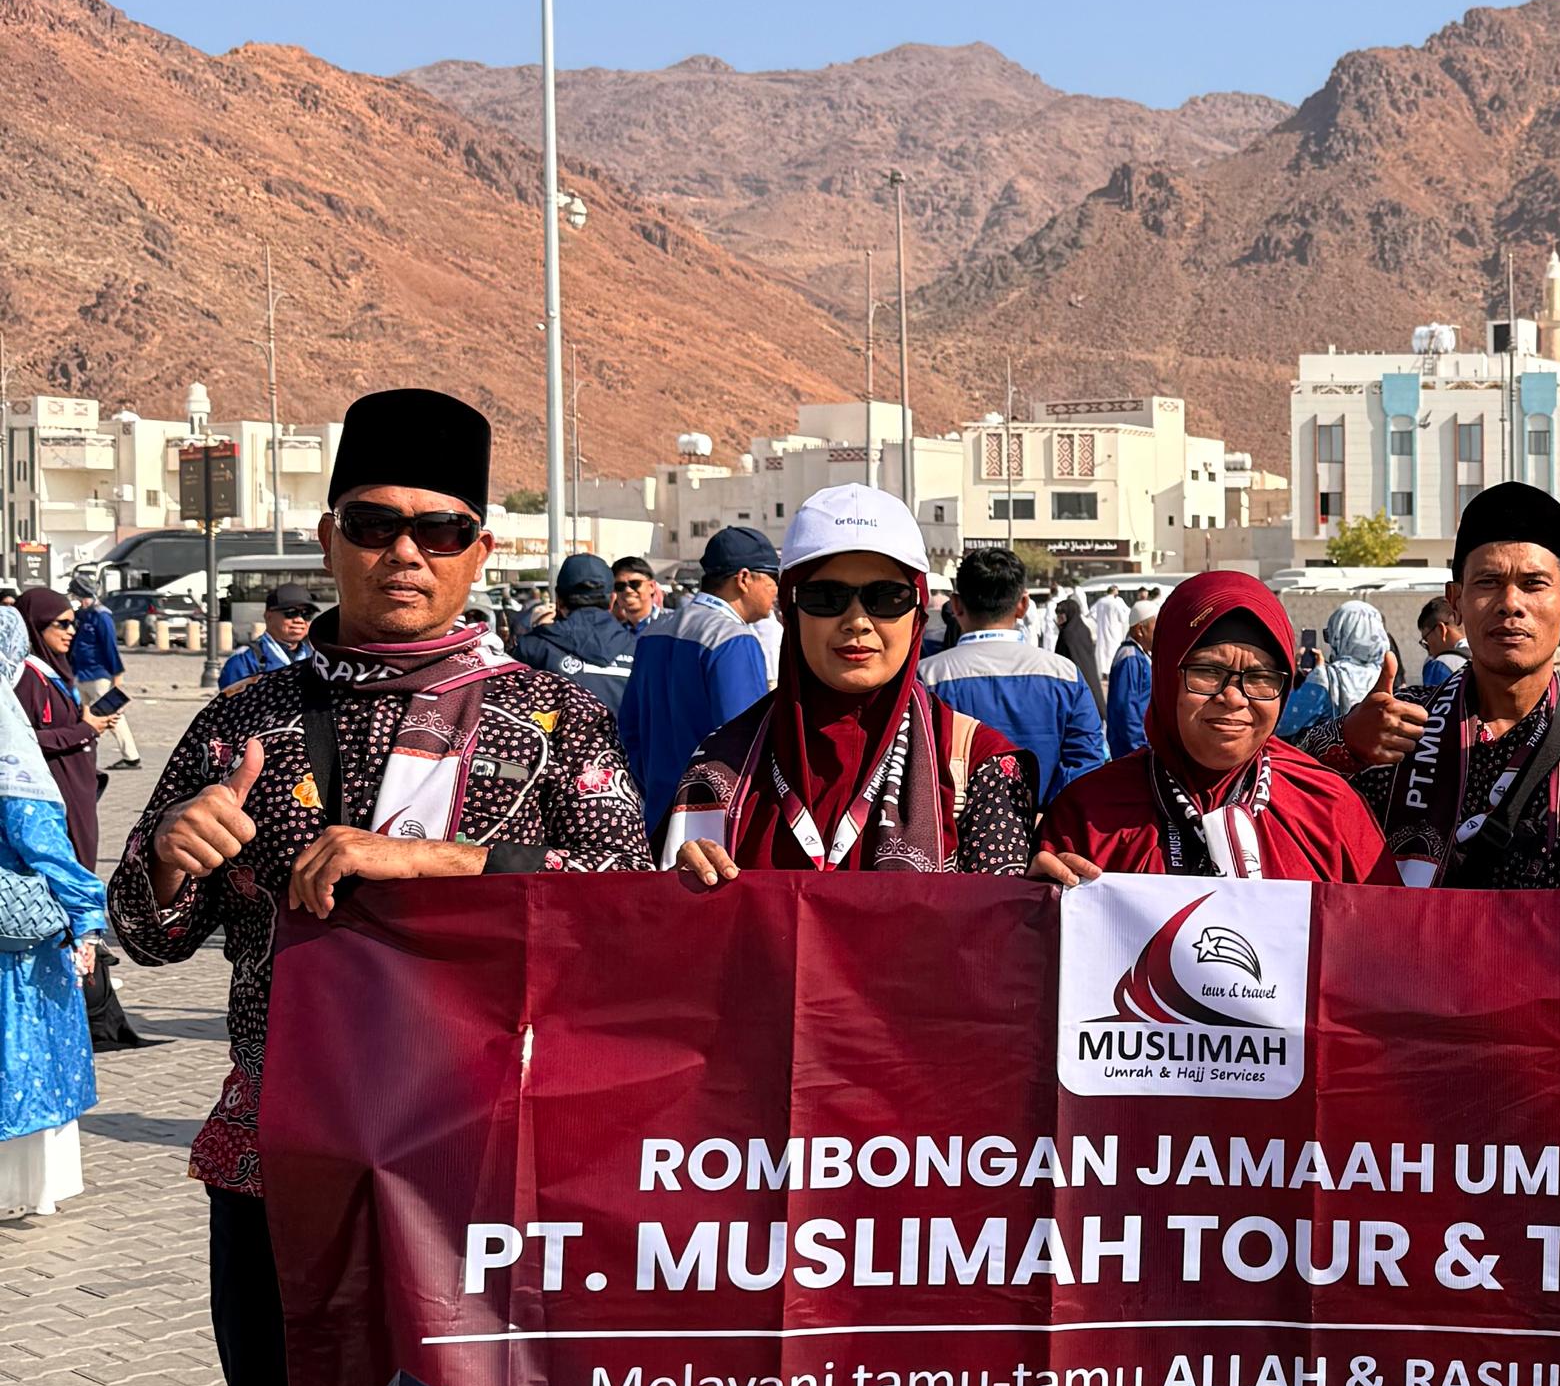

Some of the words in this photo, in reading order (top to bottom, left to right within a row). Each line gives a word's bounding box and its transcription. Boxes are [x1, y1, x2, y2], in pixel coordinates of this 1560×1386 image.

[1202, 984, 1225, 997] tour
[1229, 983, 1239, 997] &
[1242, 985, 1276, 998] travel
[1079, 1027, 1286, 1065] MUSLIMAH
[1104, 1066, 1153, 1078] Umrah
[1159, 1067, 1171, 1078] &
[1177, 1067, 1205, 1082] Hajj
[1210, 1068, 1266, 1082] Services
[640, 1136, 1117, 1190] ROMBONGAN
[1137, 1136, 1434, 1192] JAMAAH
[465, 1222, 607, 1294] PT.
[637, 1216, 1141, 1290] MUSLIMAH
[1168, 1216, 1409, 1286] TOUR
[1435, 1222, 1503, 1289] &
